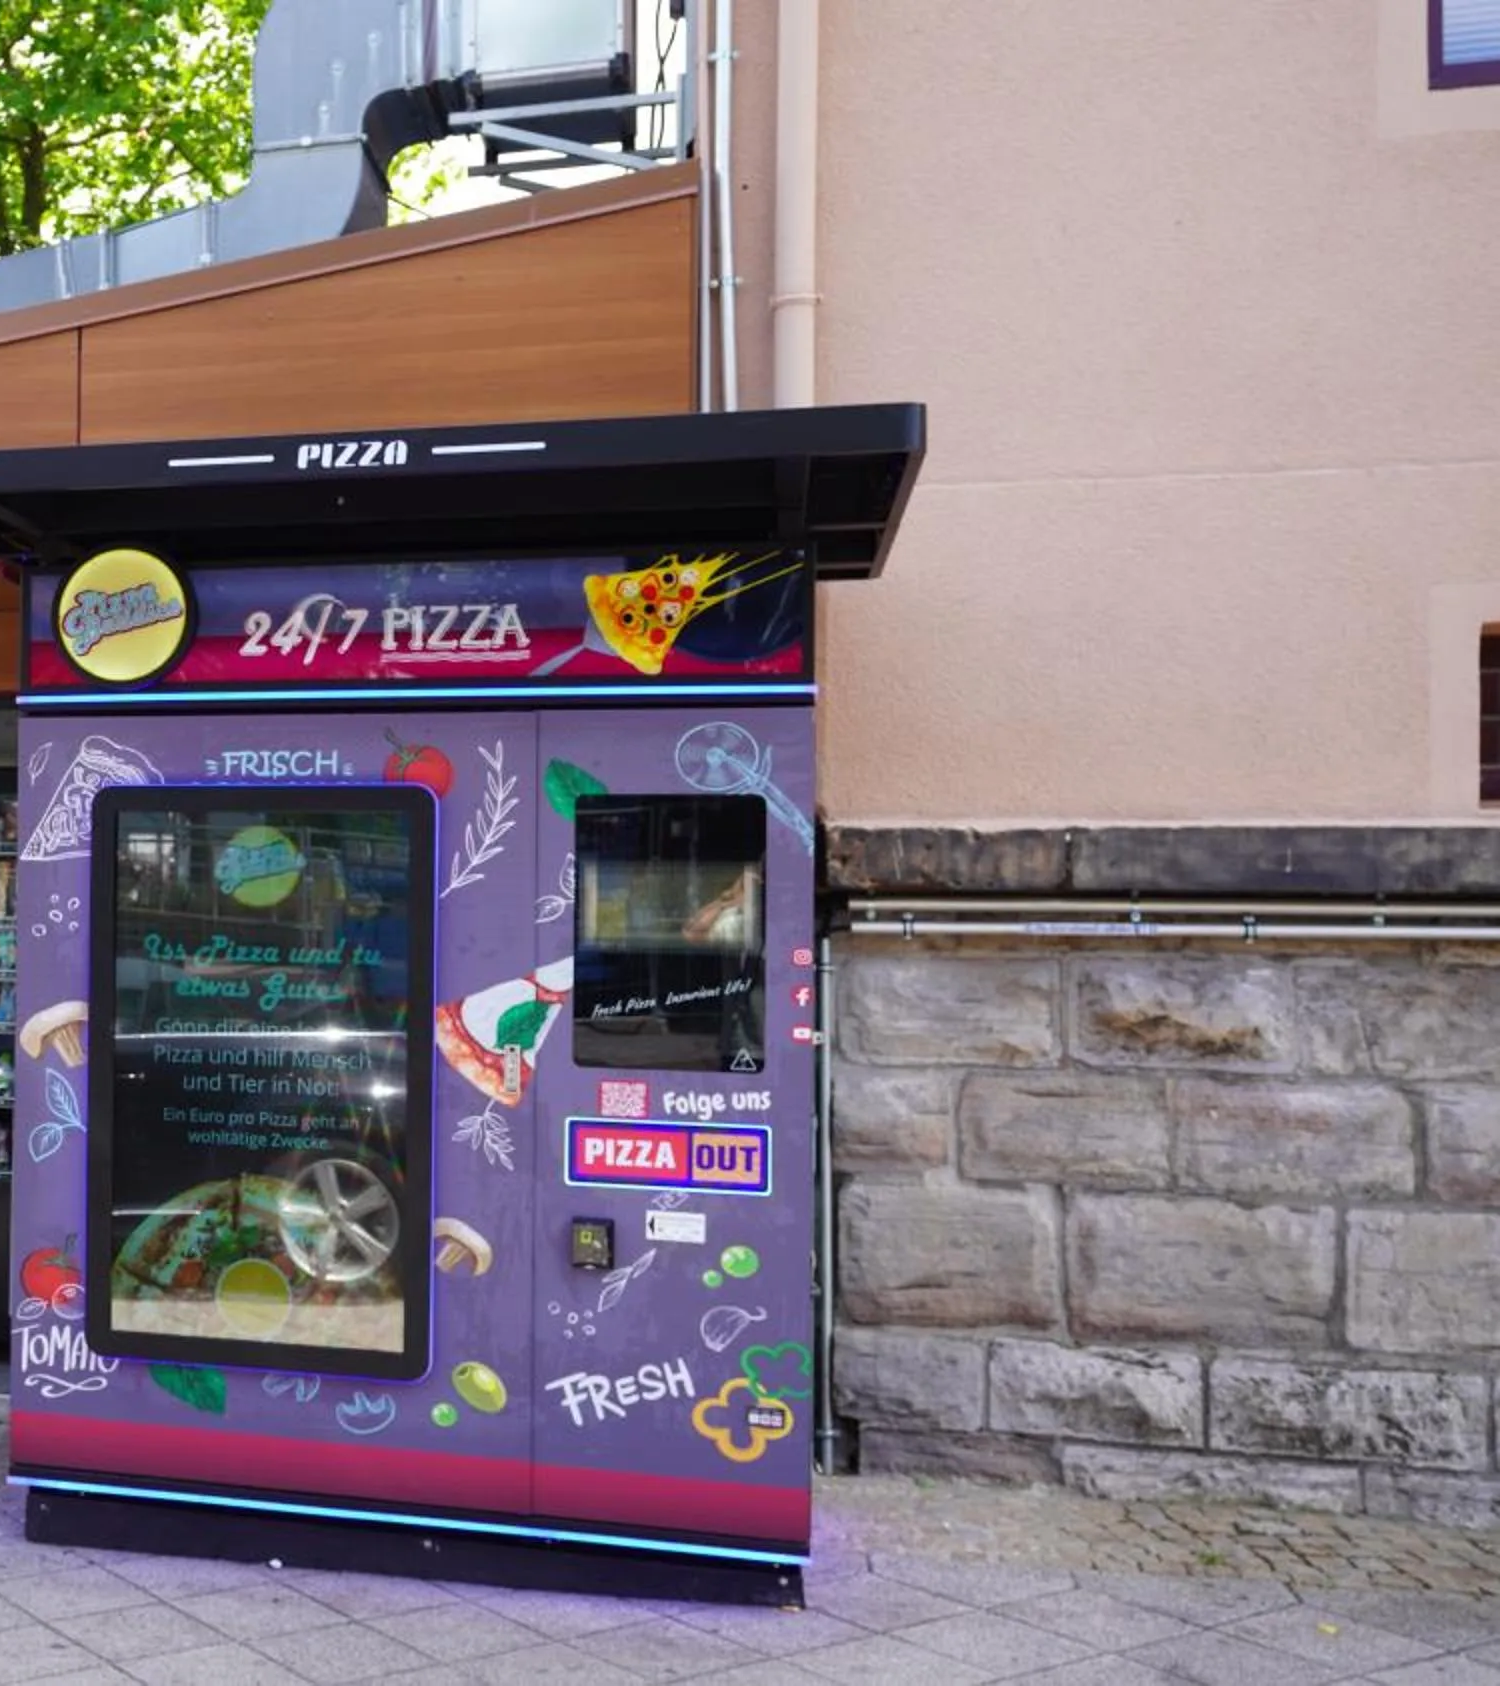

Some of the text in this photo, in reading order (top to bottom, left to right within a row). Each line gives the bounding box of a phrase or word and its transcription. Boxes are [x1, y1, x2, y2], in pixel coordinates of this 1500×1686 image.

[297, 440, 408, 469] PIZZA
[239, 601, 368, 666] 24/7
[380, 603, 531, 652] PIZZA
[221, 749, 338, 779] FRISCH
[193, 935, 281, 967] Pizza
[289, 937, 347, 964] und
[352, 944, 383, 966] tu
[176, 972, 349, 1011] etwas Gutes
[153, 1043, 374, 1072] Pizza und hilf Mensch
[182, 1074, 222, 1092] und
[228, 1073, 267, 1094] Tier
[272, 1074, 292, 1094] in
[163, 1107, 187, 1122] Ein
[190, 1108, 225, 1125] Euro
[228, 1111, 256, 1129] pro
[259, 1112, 298, 1128] Pizza
[662, 1090, 773, 1121] Folge uns
[584, 1137, 759, 1172] PIZZA OUT
[544, 1357, 696, 1427] FRESH
